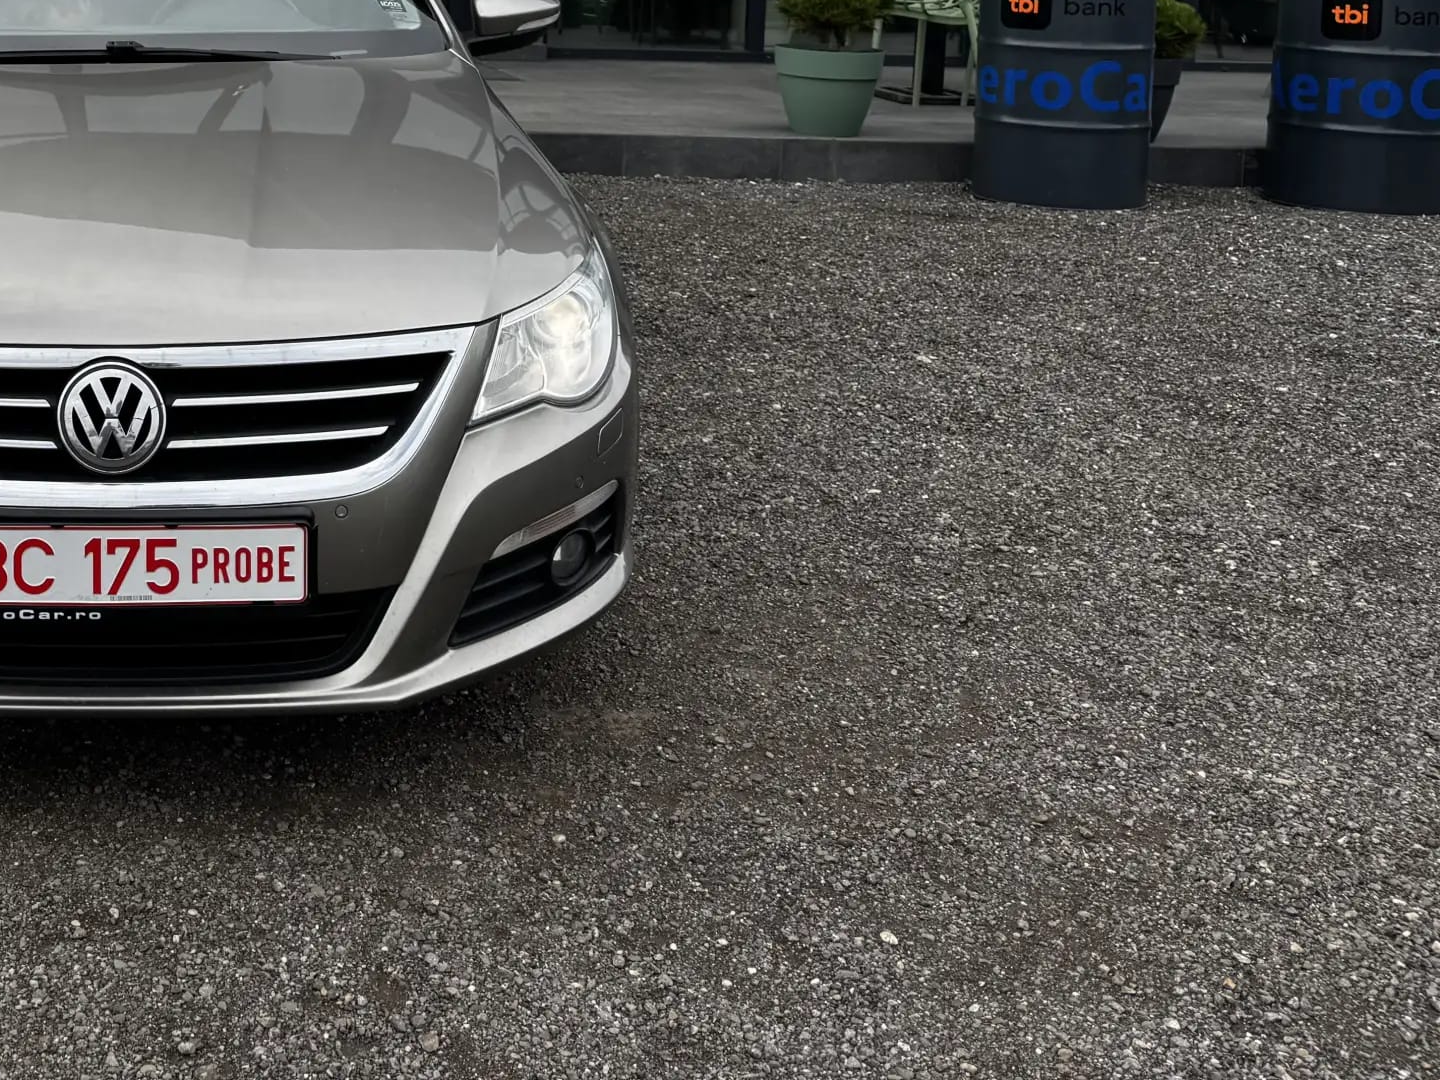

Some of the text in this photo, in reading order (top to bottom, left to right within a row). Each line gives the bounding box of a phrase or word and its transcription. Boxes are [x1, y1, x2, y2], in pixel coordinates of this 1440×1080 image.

[1331, 3, 1440, 27] tbi ban
[84, 538, 180, 595] 175
[191, 545, 296, 585] PROBE
